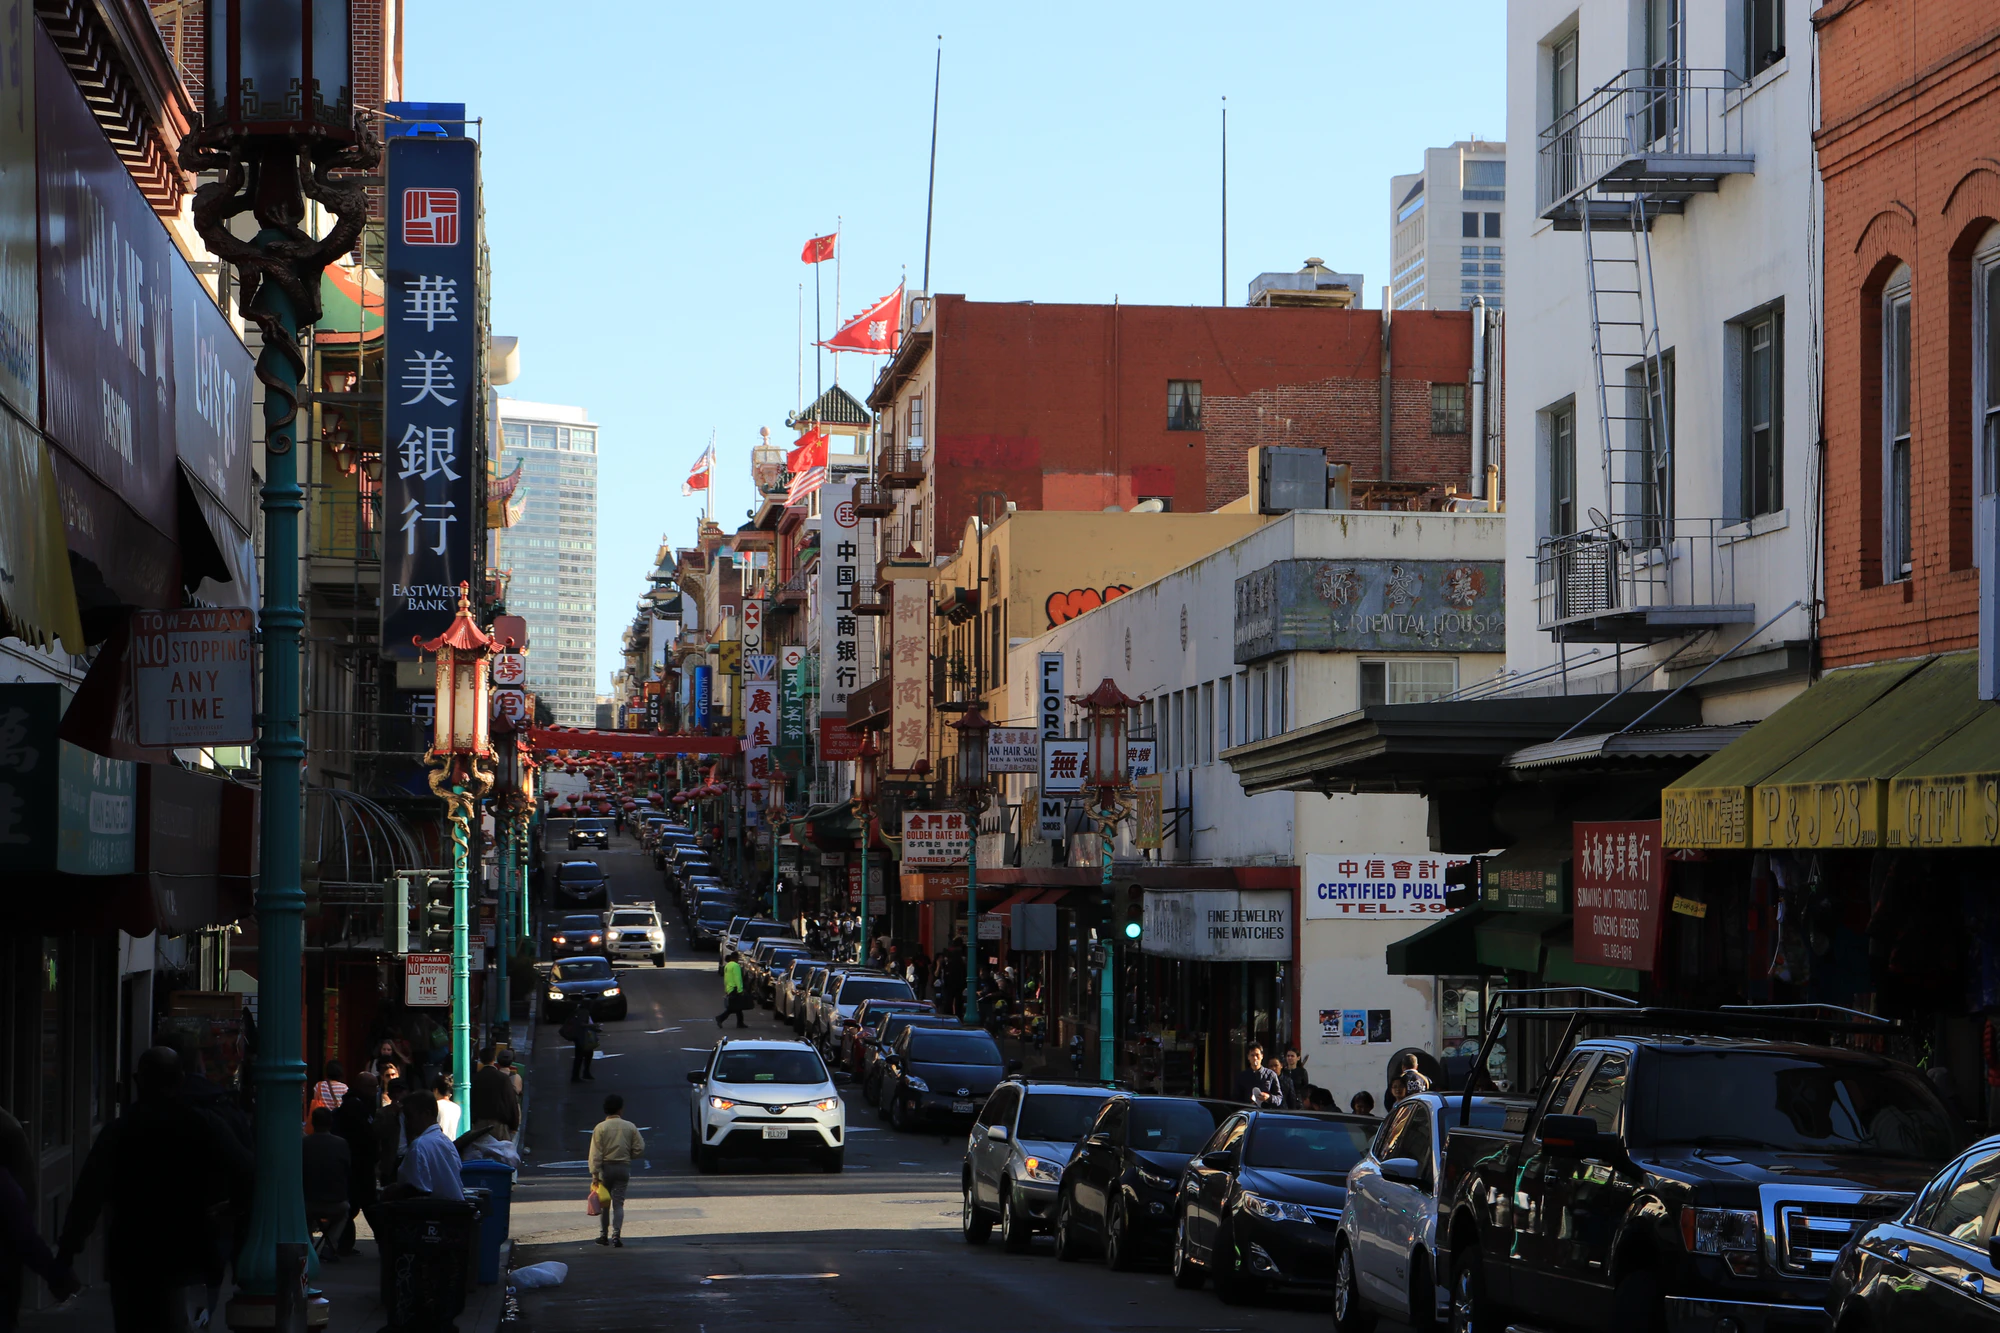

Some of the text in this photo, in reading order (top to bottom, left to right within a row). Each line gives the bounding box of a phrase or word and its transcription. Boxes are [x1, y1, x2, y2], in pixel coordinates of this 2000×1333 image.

[102, 377, 134, 466] FASHION
[397, 275, 461, 556] 華美銀行
[140, 611, 246, 631] TOW-AWAY
[836, 540, 857, 689] 中国工商银行
[136, 634, 247, 664] NO STOPPING
[171, 670, 219, 693] ANY
[166, 698, 225, 720] TIME
[1003, 746, 1021, 756] HAIR
[1762, 787, 1780, 846] P
[1785, 796, 1800, 845] &
[1809, 785, 1824, 846] J
[1905, 780, 1999, 843] GIFT S
[908, 814, 962, 829] 金門餅
[1043, 822, 1060, 831] SHOES
[906, 830, 932, 840] GOLDEN
[935, 830, 952, 840] GATE
[928, 877, 969, 885] 中秋月
[1317, 883, 1396, 900] CERTIFIED
[1614, 889, 1637, 910] TRADING
[1207, 909, 1285, 923] FINE JEWELRY
[1207, 926, 1285, 940] FINE WATCHES
[1593, 915, 1640, 939] GINSENG HERBS
[408, 963, 448, 975] NO STOPPING
[420, 976, 437, 985] ANY
[418, 986, 437, 995] TIME
